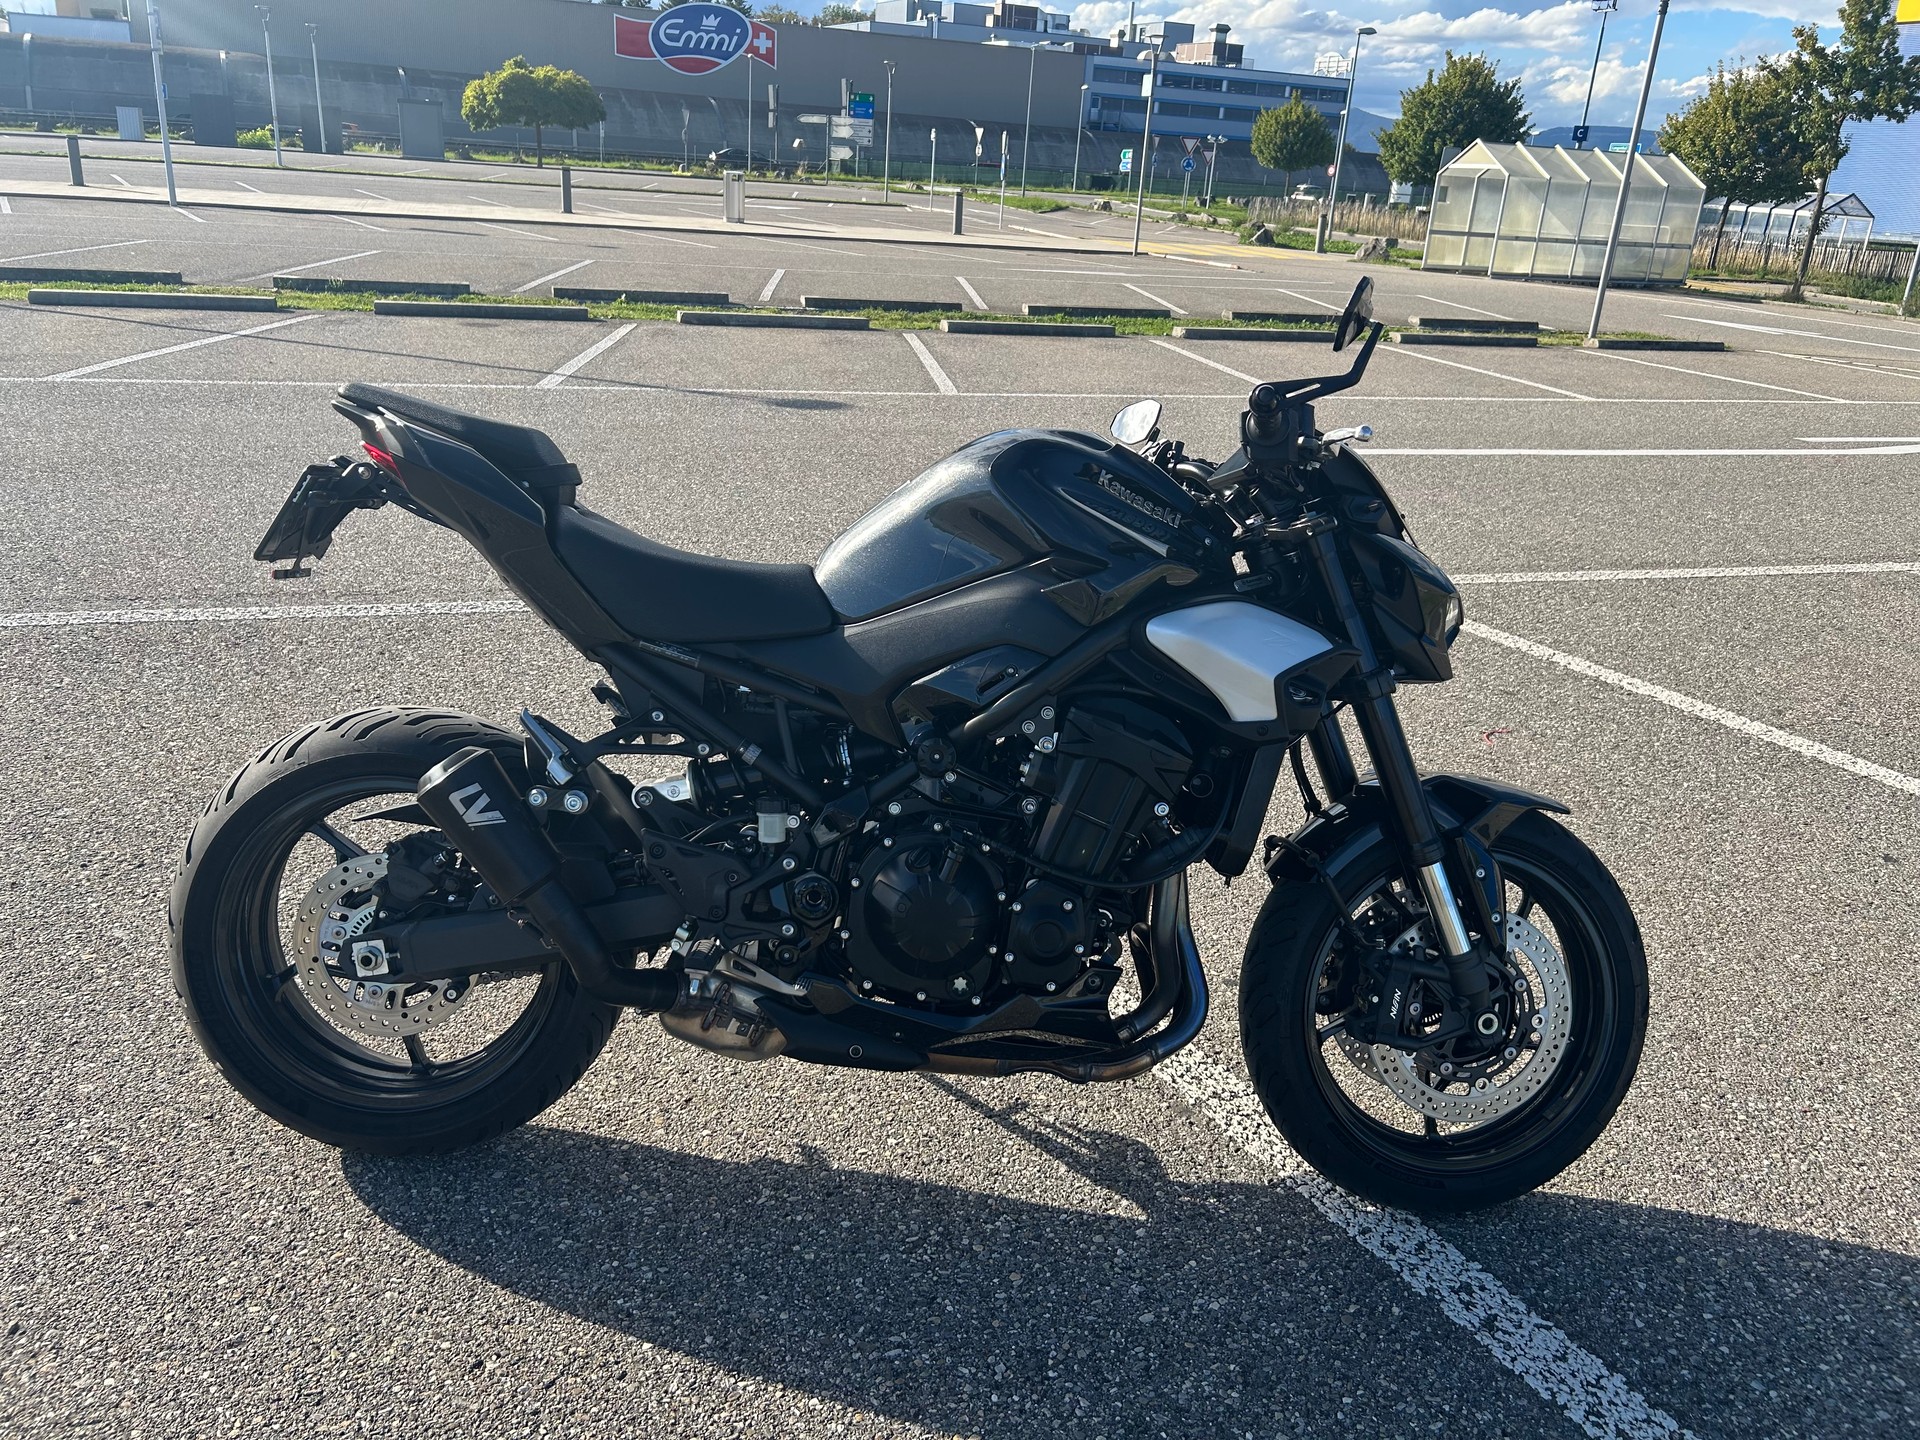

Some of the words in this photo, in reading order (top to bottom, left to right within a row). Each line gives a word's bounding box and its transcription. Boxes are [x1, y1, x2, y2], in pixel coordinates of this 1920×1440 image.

[659, 18, 741, 52] Emmi
[1577, 129, 1584, 137] C
[1097, 469, 1181, 529] Kawasaki
[448, 782, 506, 827] LV
